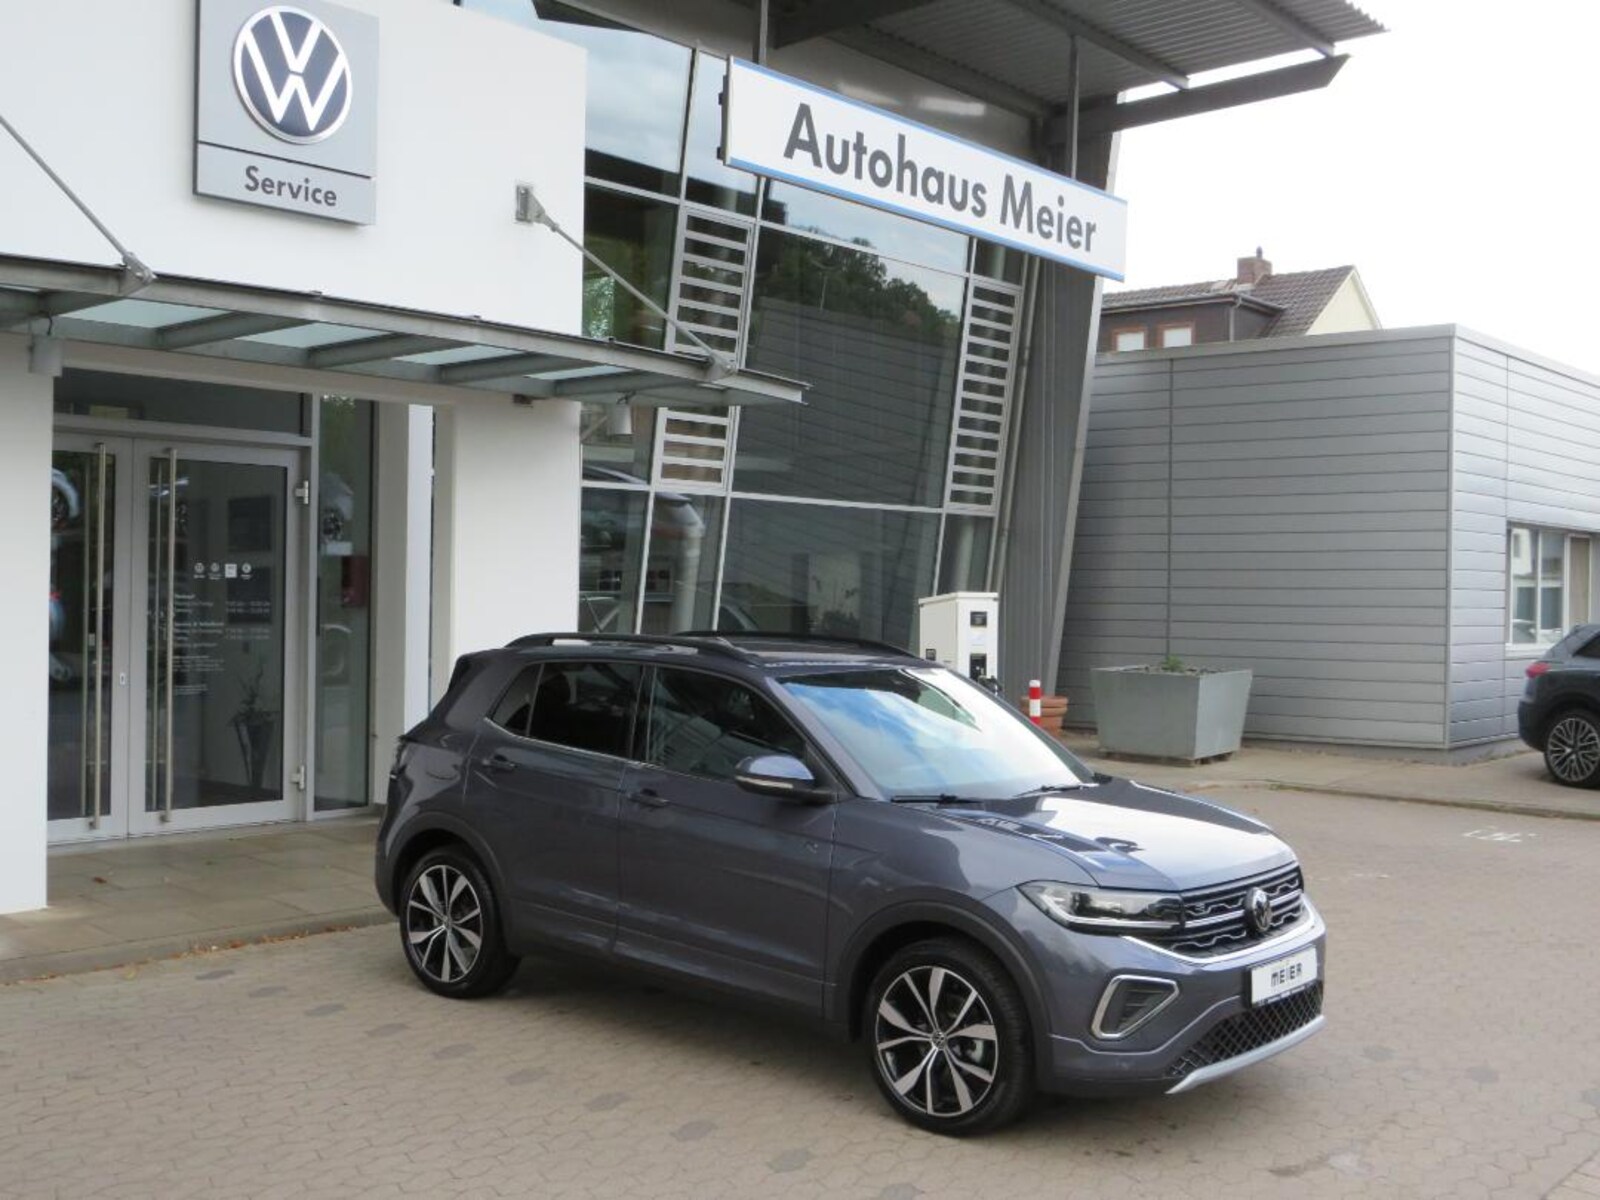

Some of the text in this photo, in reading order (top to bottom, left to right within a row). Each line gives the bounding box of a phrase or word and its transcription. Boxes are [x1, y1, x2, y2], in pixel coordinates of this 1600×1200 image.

[244, 165, 337, 206] Service
[783, 102, 1097, 252] Autohaus Meier
